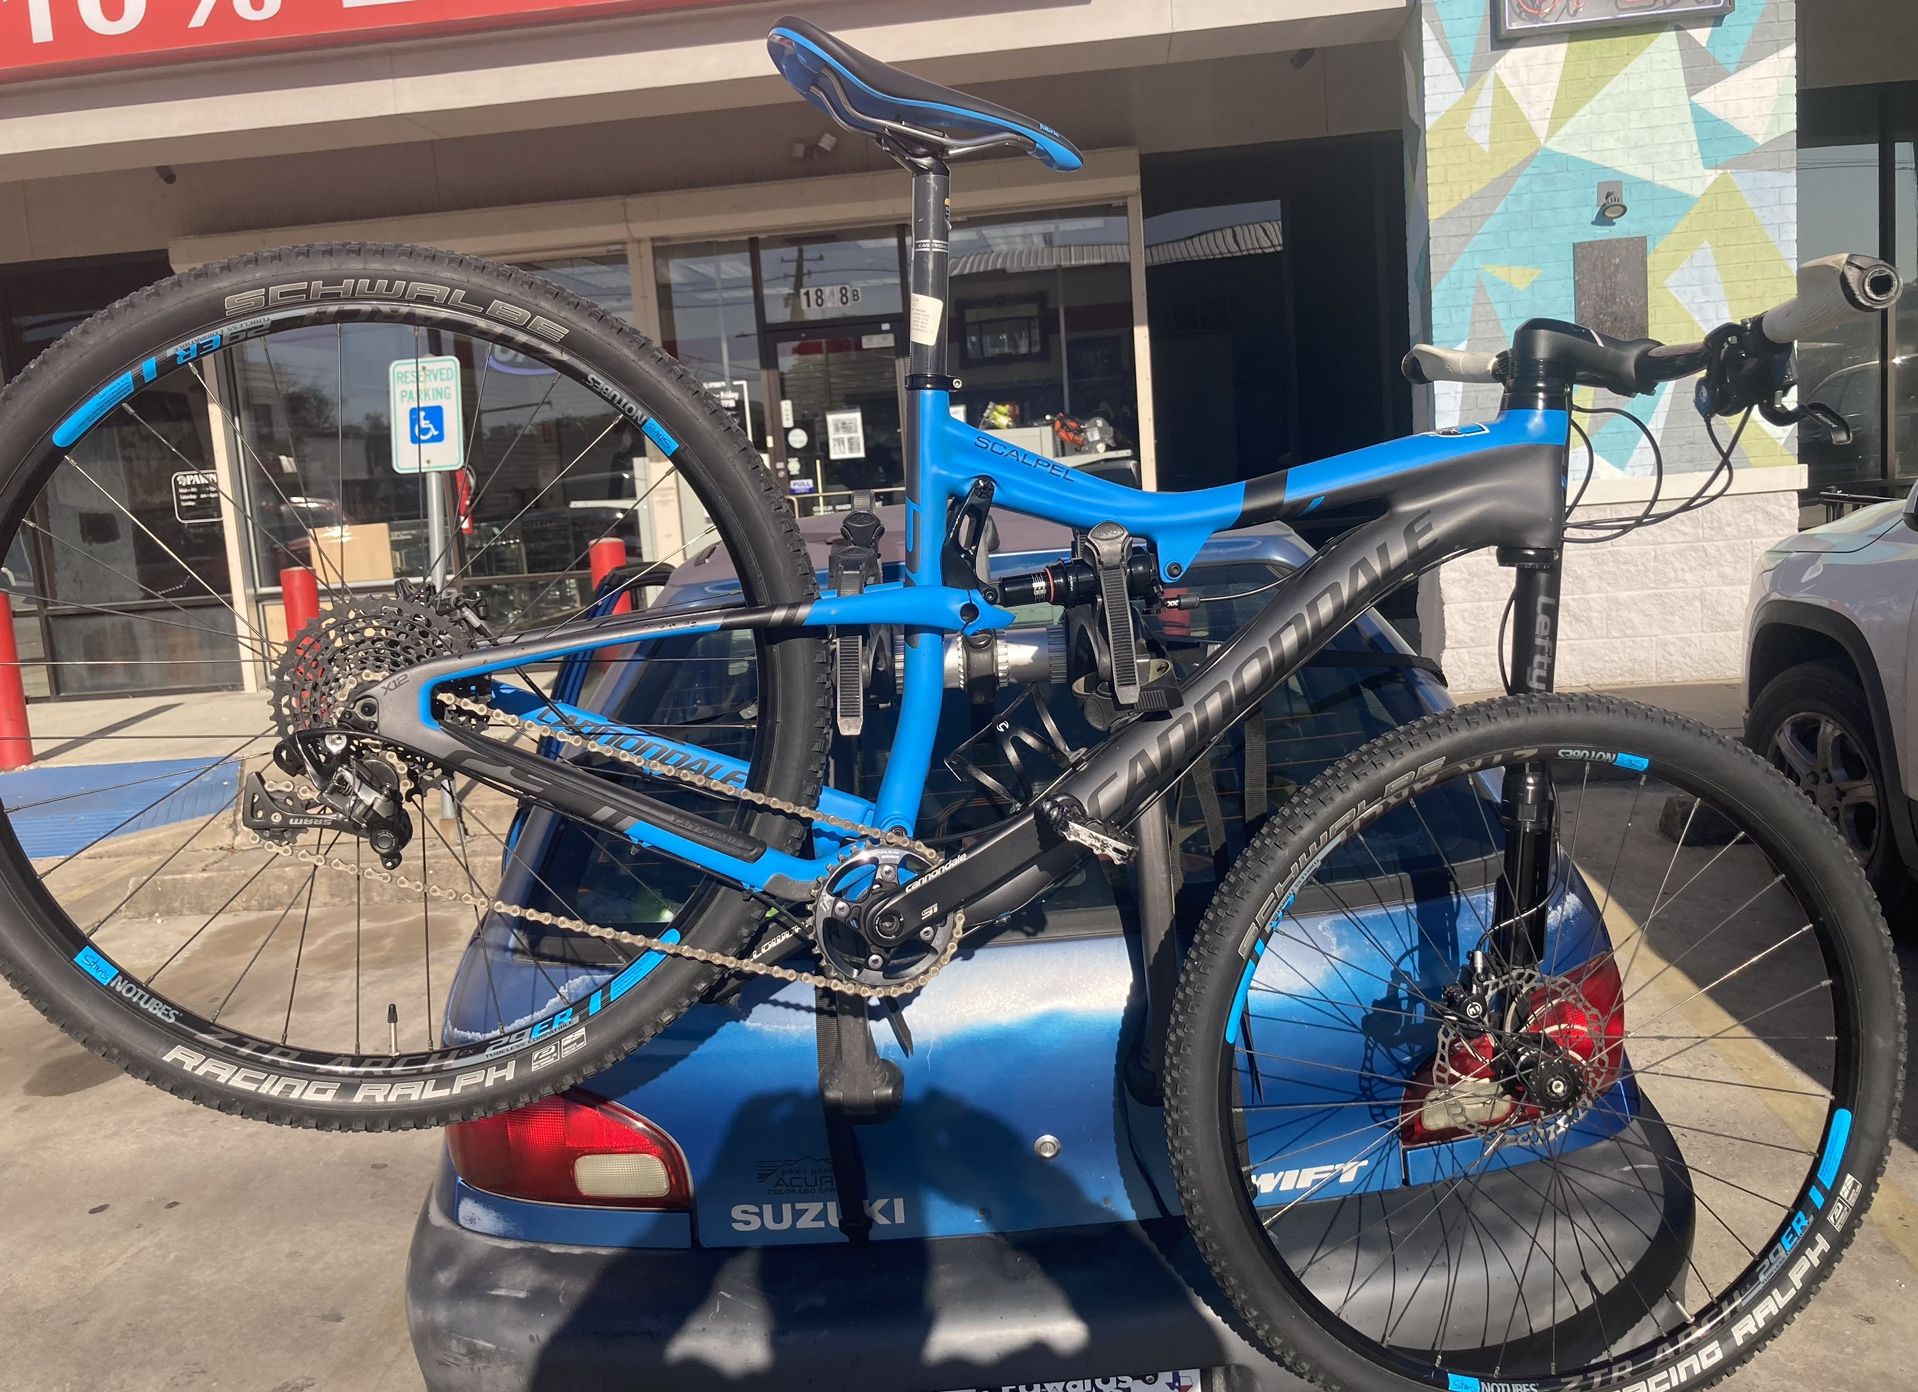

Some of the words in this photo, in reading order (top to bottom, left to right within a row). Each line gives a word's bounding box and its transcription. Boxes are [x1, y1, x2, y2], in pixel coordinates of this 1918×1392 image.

[224, 278, 570, 343] SCHWALBE
[396, 367, 455, 385] RESERVED
[400, 386, 452, 404] PARKING
[585, 373, 648, 425] NOTUBES
[973, 435, 1075, 483] SCALPEL
[1087, 508, 1440, 823] CANNONDALE
[1526, 595, 1557, 690] Lefty
[380, 673, 411, 697] X12
[904, 852, 968, 894] cannondale
[1237, 755, 1446, 960] SCHWALBE
[110, 975, 177, 1025] NOTUBES
[485, 1007, 574, 1055] 29ER
[162, 1044, 338, 1103] RACING
[352, 1059, 516, 1104] RALPH
[774, 1174, 836, 1188] ACUR
[1250, 1160, 1369, 1194] WIFT
[1755, 1210, 1809, 1282] 29ER
[1730, 1232, 1831, 1347] RALPH
